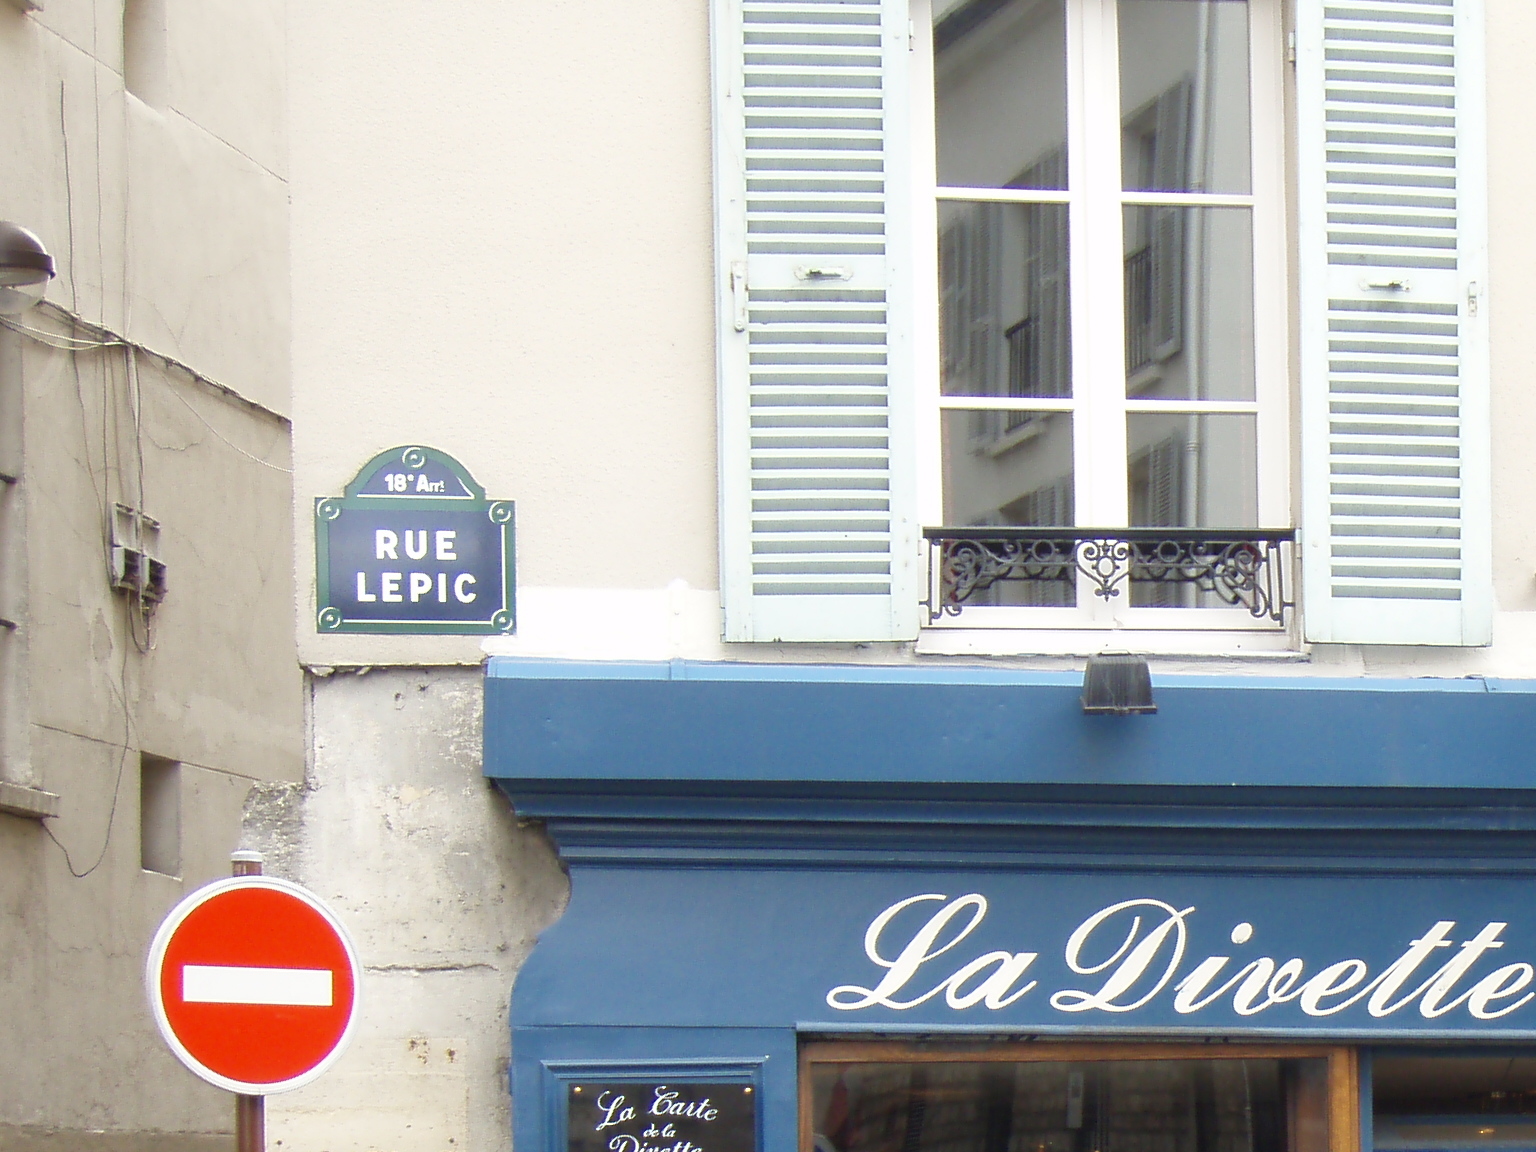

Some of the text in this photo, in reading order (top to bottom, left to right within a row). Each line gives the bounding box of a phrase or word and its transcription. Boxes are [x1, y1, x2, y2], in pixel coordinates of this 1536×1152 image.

[376, 529, 456, 560] RUE
[357, 572, 477, 603] LEPIC
[826, 892, 1039, 1011] La
[1050, 898, 1535, 1020] Divette
[596, 1086, 718, 1130] La Carte
[643, 1123, 676, 1138] de la
